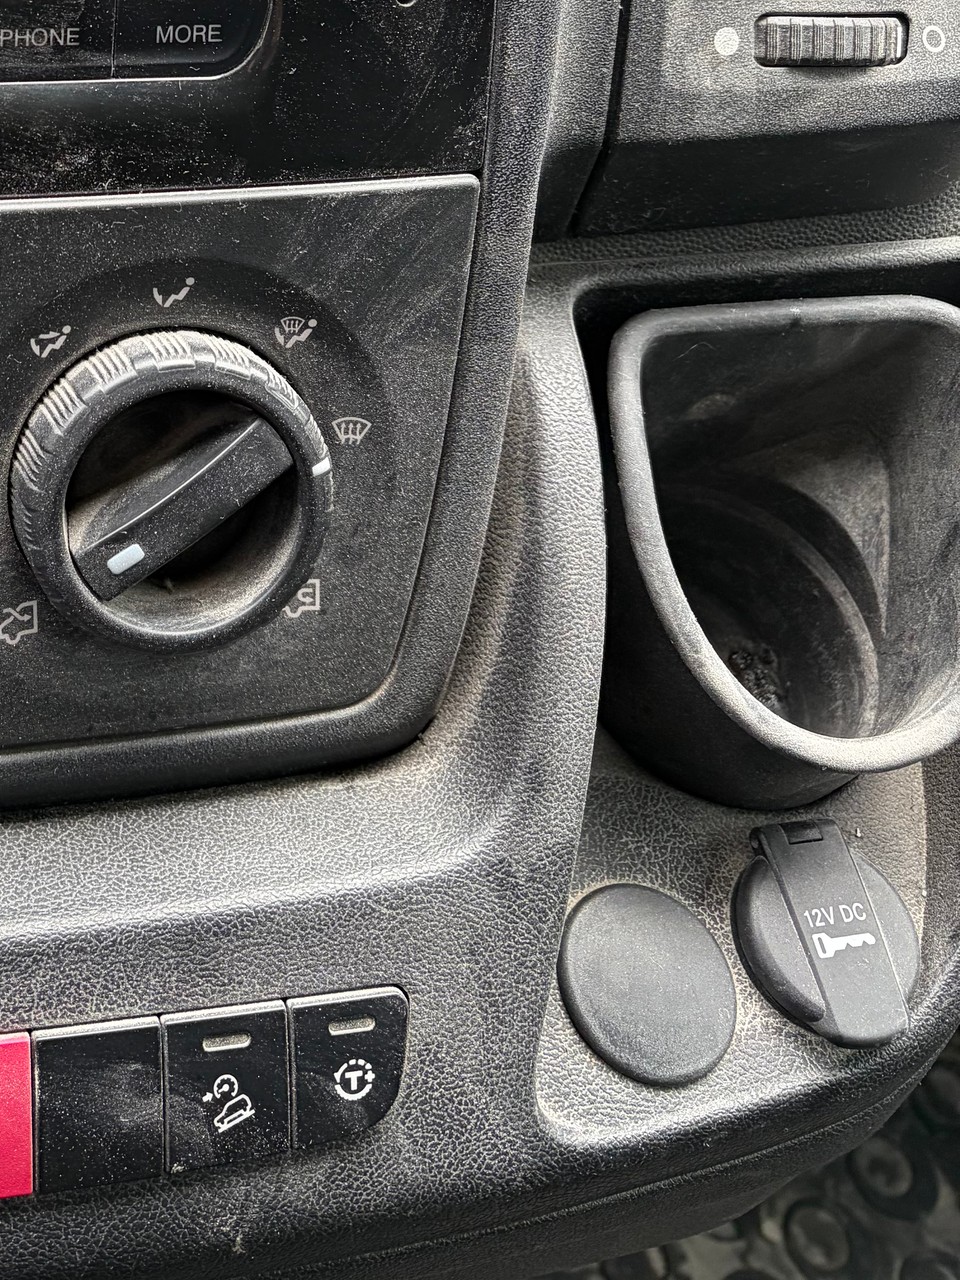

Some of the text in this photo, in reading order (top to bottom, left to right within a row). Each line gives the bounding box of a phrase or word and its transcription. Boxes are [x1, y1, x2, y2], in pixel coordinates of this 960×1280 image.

[0, 27, 80, 48] PHONE
[155, 24, 223, 44] MORE
[803, 902, 867, 928] 12V DC
